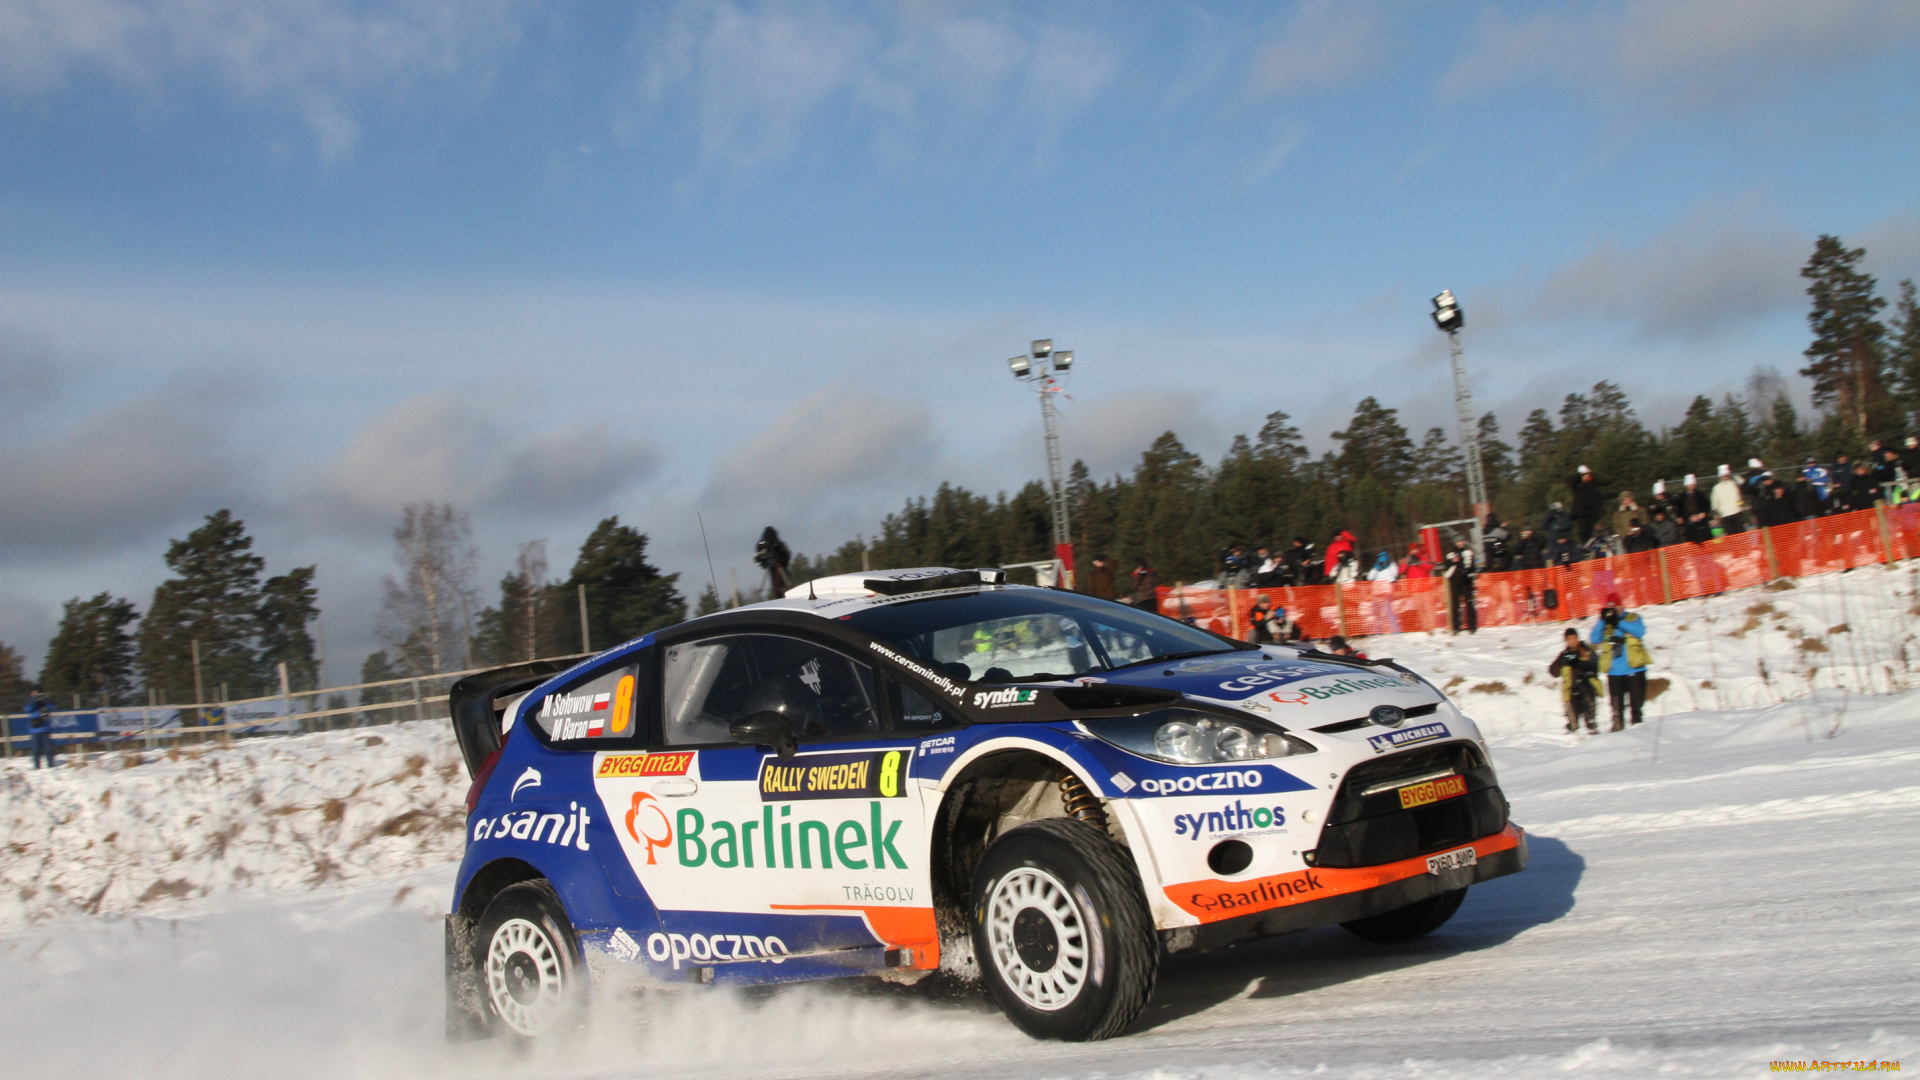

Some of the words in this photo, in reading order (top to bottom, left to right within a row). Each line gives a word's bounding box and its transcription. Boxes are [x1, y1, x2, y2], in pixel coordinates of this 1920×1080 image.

[870, 642, 966, 696] www.cersanitrally.pl
[541, 695, 553, 717] M
[611, 675, 635, 733] 8
[973, 687, 1039, 709] synthos
[551, 719, 563, 741] M
[562, 718, 588, 740] Baran
[921, 737, 955, 749] GETCAR
[1392, 724, 1445, 744] MICHELIN
[763, 765, 806, 792] RALLY
[807, 760, 870, 791] SWEDEN
[880, 751, 901, 797] 8
[1141, 770, 1263, 795] opoczno
[676, 801, 909, 869] Barlinek
[1174, 799, 1286, 841] synthos
[842, 883, 914, 901] TRÄGOLV
[1217, 870, 1324, 909] Barlinek
[647, 932, 790, 970] opoczno
